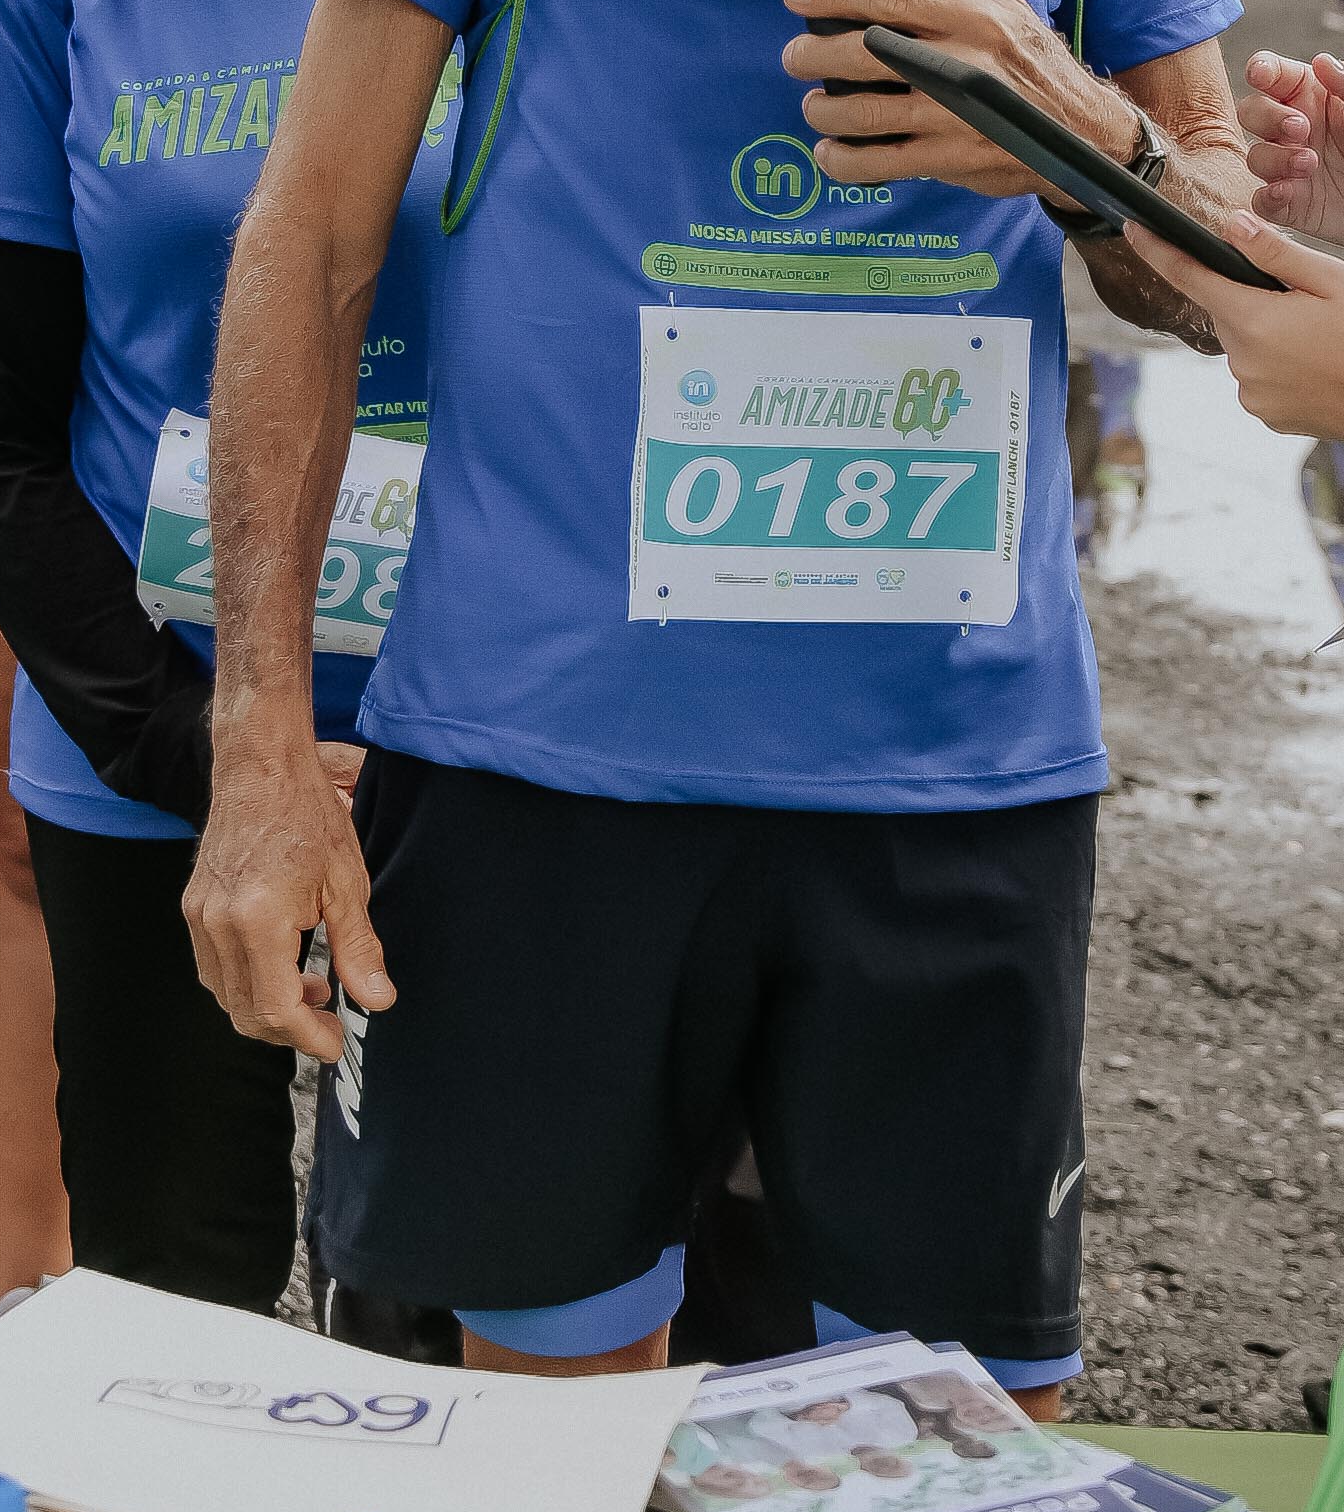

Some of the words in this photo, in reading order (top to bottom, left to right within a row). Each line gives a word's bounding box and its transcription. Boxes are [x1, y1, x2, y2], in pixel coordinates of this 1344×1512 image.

[120, 73, 196, 91] CORRIDA
[217, 56, 296, 80] CAMINHA
[99, 74, 300, 167] AMIZA
[753, 157, 803, 198] in
[827, 183, 894, 205] nata
[689, 223, 748, 243] NOSSA
[750, 228, 817, 246] MISSÃO
[820, 228, 831, 245] É
[835, 232, 915, 249] IMPACTAR
[918, 234, 959, 250] VIDAS
[687, 379, 709, 397] in
[356, 401, 404, 418] ACTAR
[673, 408, 722, 422] instituto
[739, 384, 895, 429] AMIZADE
[892, 367, 973, 441] 60+
[1008, 390, 1021, 435] -0187
[681, 420, 712, 432] nata
[1006, 438, 1019, 486] LANCHE
[664, 455, 978, 541] 0187
[1005, 488, 1016, 512] KIT
[1003, 510, 1015, 531] UM
[1001, 532, 1013, 563] VALE
[173, 527, 407, 621] 298
